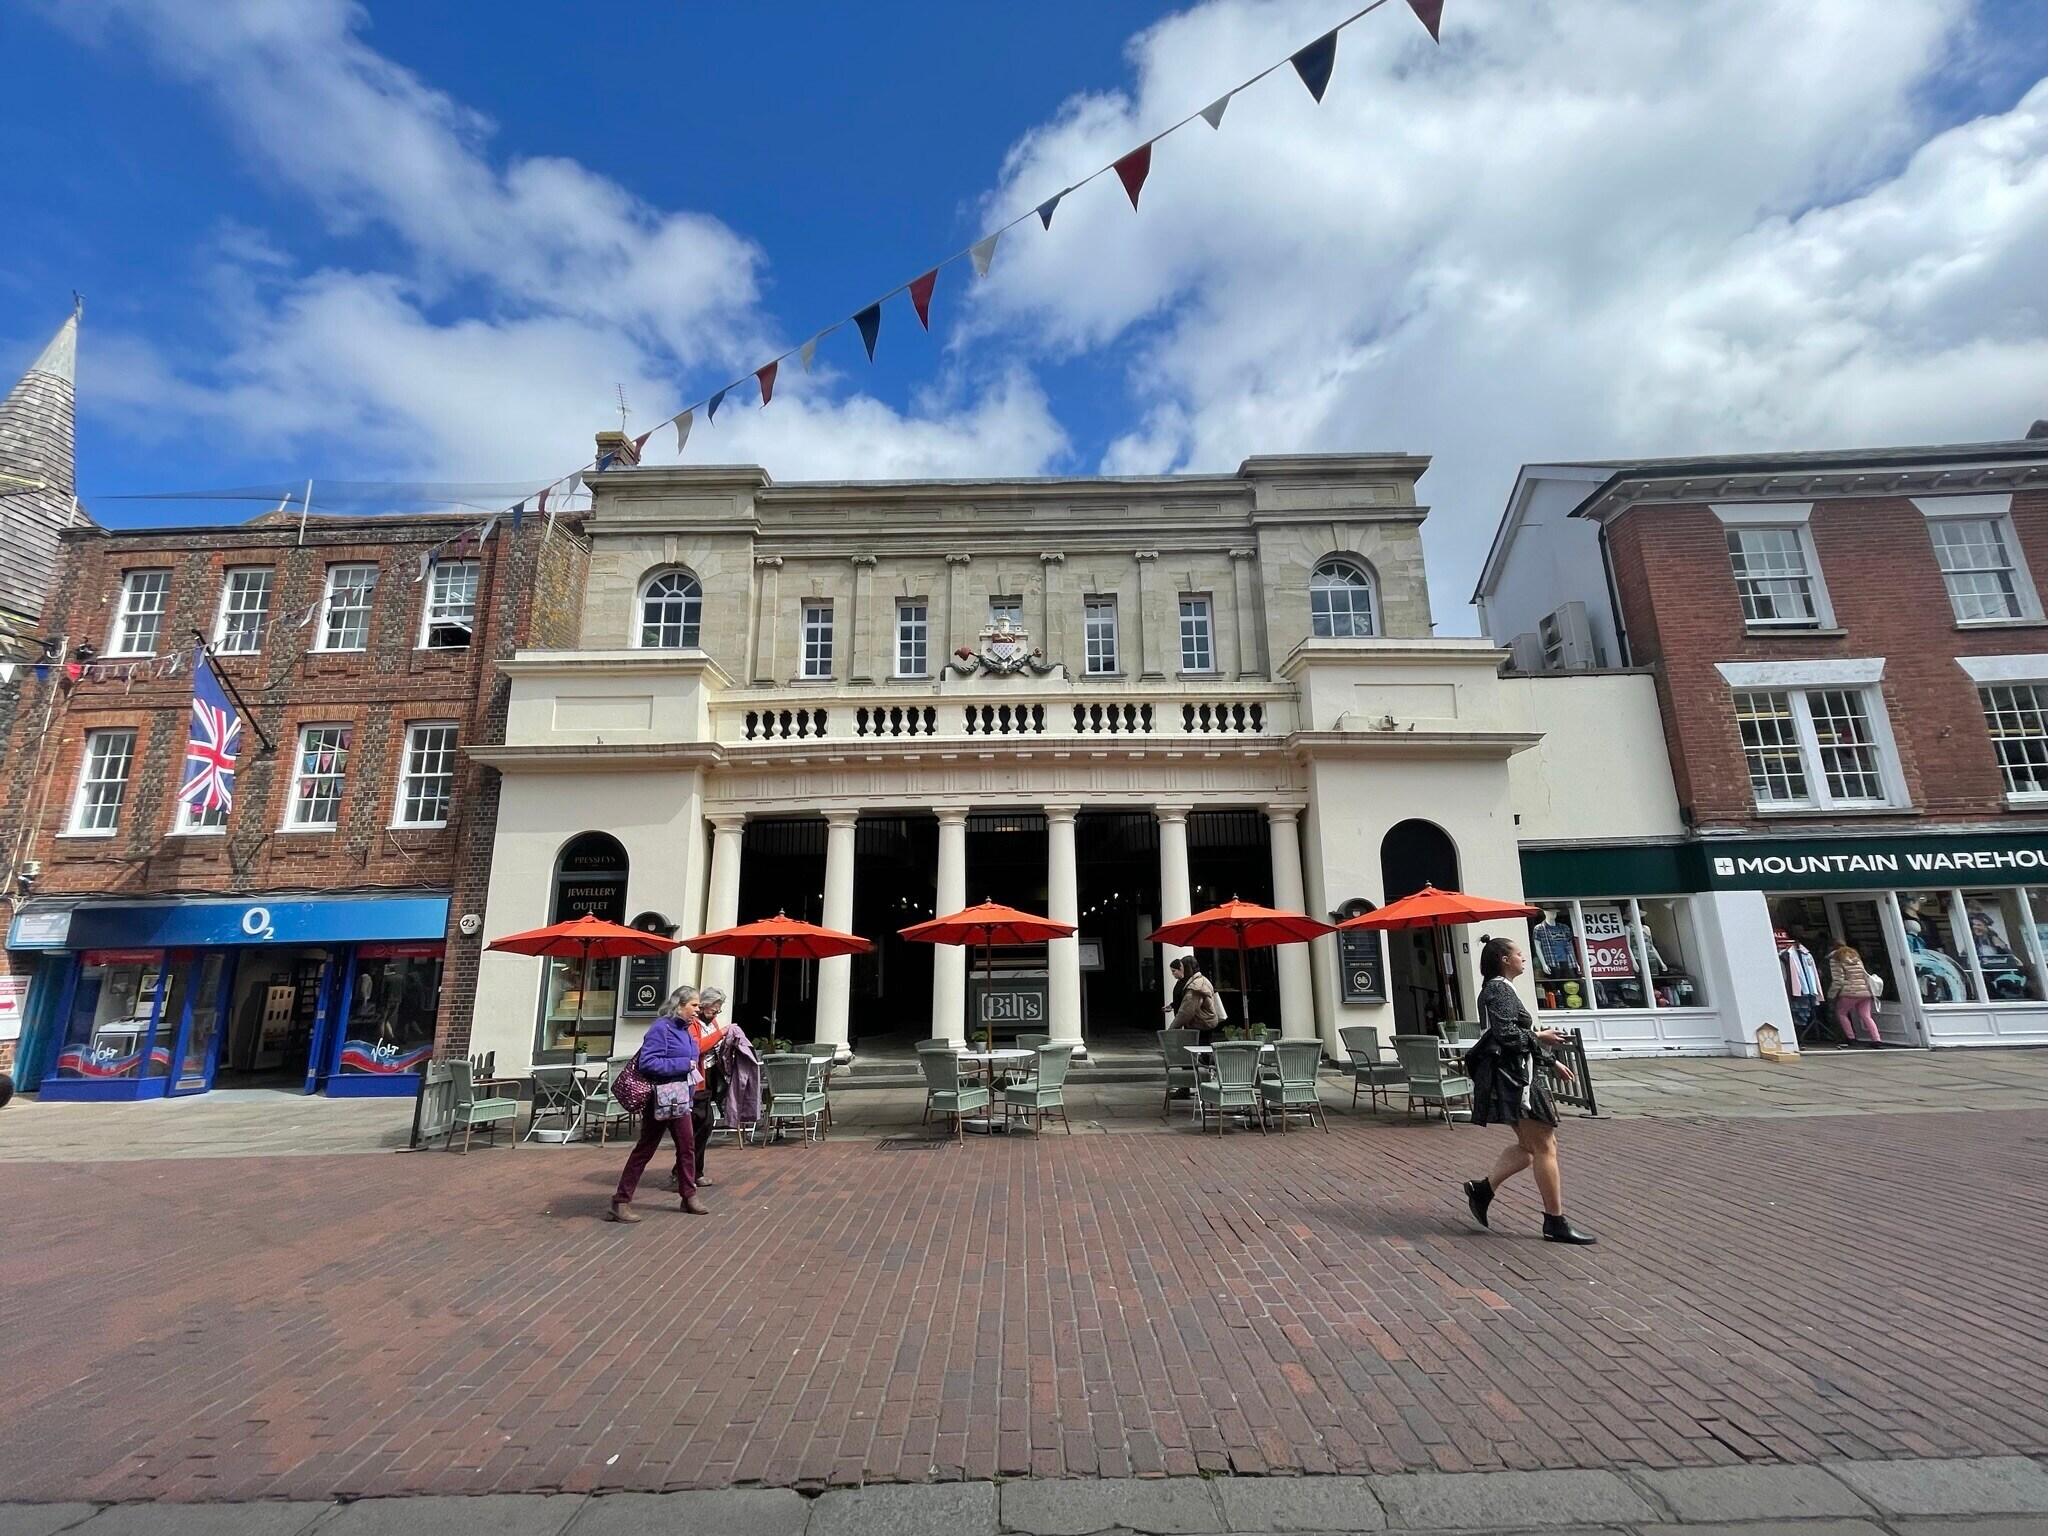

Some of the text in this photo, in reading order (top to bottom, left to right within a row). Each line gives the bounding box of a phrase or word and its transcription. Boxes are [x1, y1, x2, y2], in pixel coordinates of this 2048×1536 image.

[1739, 854, 1898, 873] MOUNTAIN
[567, 887, 617, 898] JEWELLERY
[572, 902, 609, 911] OUTLET
[242, 907, 275, 940] O2
[1584, 913, 1619, 925] RICE
[1585, 925, 1621, 934] RASH
[988, 993, 1038, 1021] Bill's
